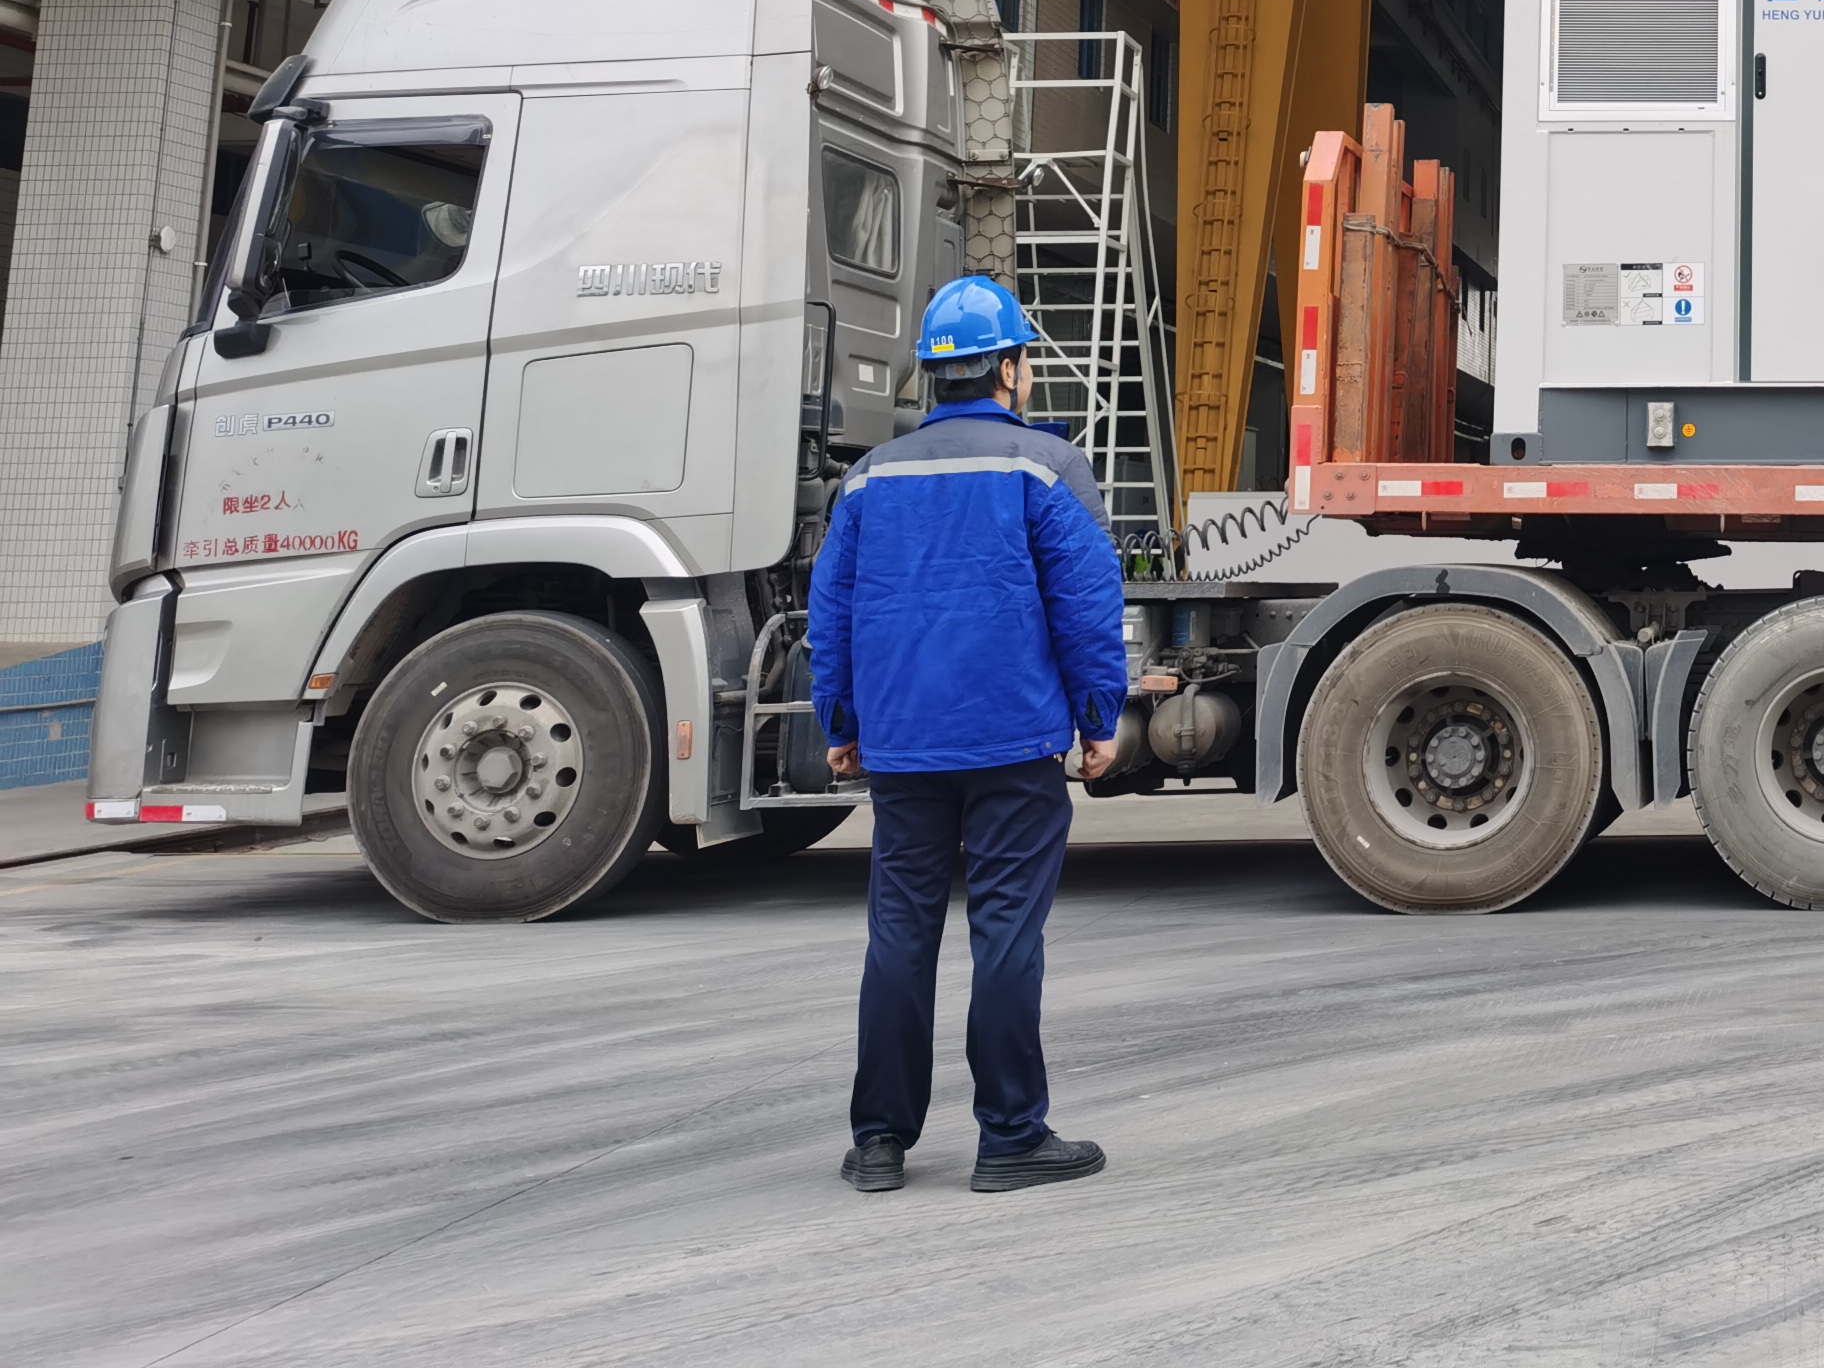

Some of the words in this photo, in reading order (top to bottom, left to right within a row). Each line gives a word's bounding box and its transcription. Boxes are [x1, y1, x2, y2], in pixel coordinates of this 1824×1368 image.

[1762, 10, 1800, 20] HENG
[577, 262, 721, 297] 四川现代
[215, 414, 258, 437] 创虎
[267, 413, 331, 428] P440
[223, 490, 291, 515] 限坐2人
